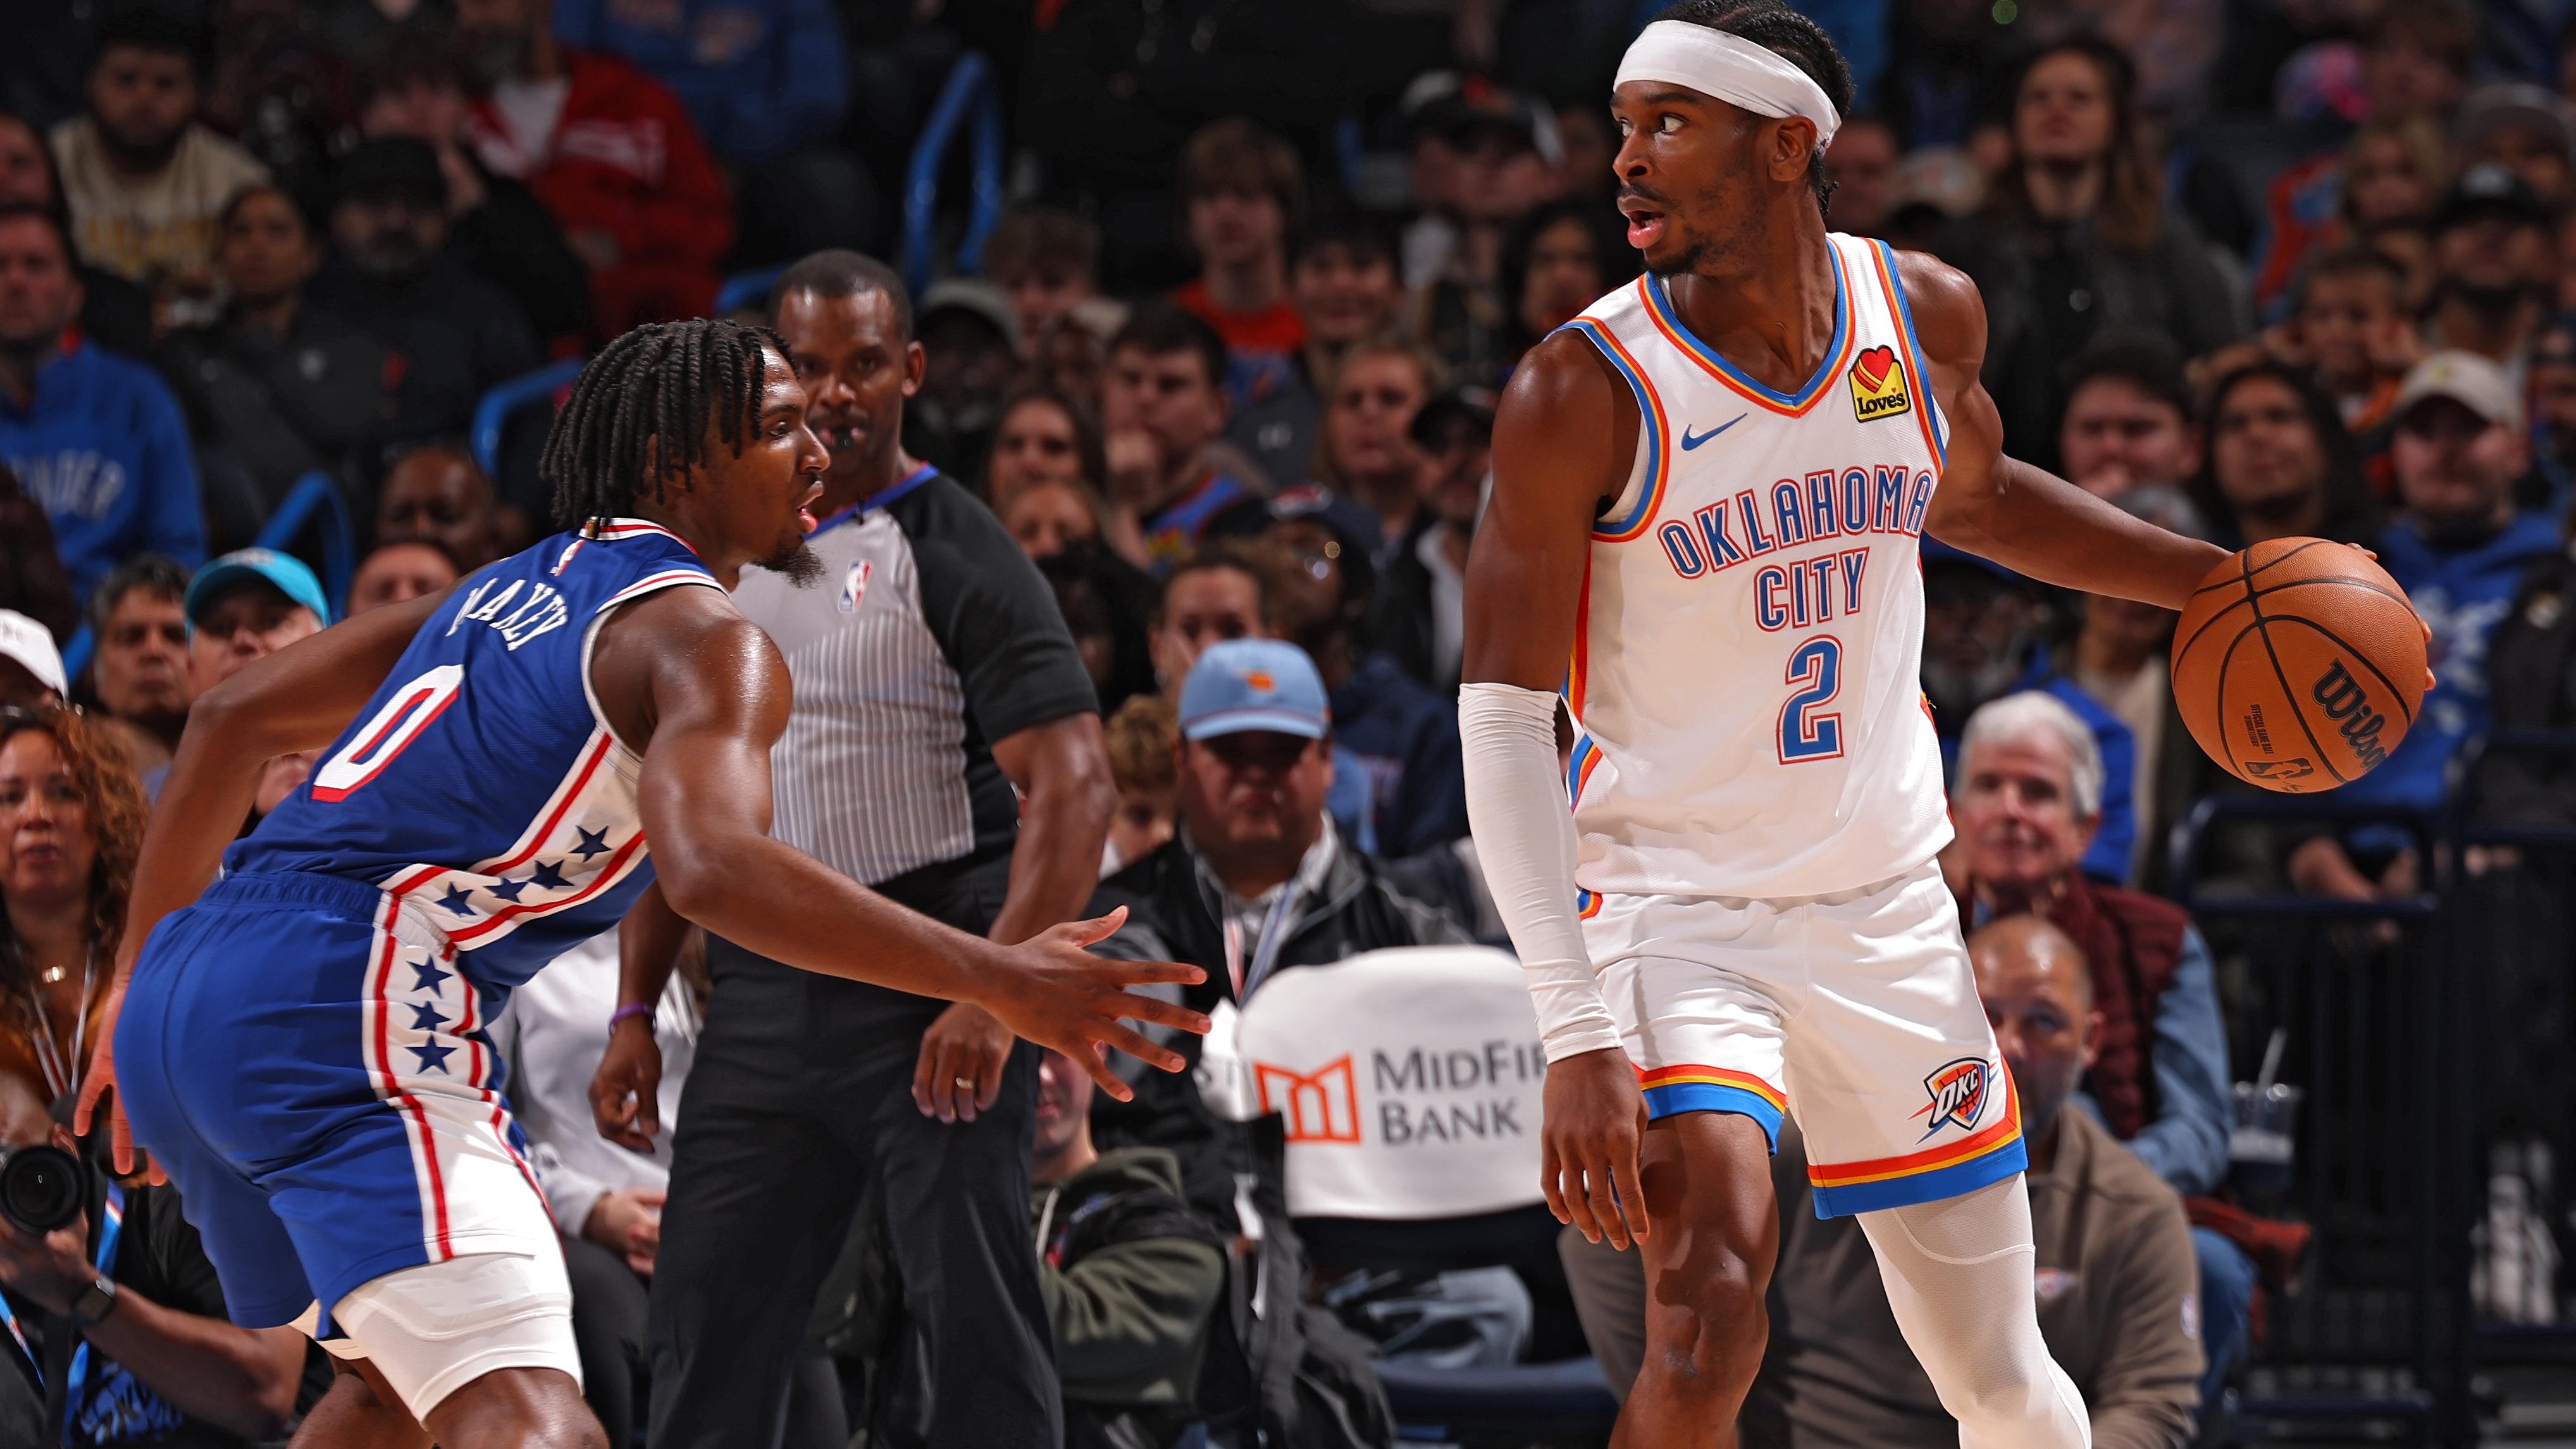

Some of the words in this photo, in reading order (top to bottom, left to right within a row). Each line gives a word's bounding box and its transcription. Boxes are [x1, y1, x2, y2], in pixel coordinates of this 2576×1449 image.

[1657, 464, 1933, 580] OKLAHOMA
[445, 577, 568, 651] MAXEY
[1754, 546, 1870, 632] CITY
[311, 664, 466, 803] 0
[1776, 634, 1844, 765] 2
[2312, 658, 2389, 774] Wilso
[1378, 1100, 1521, 1145] BANK
[1930, 1066, 1979, 1126] OKC
